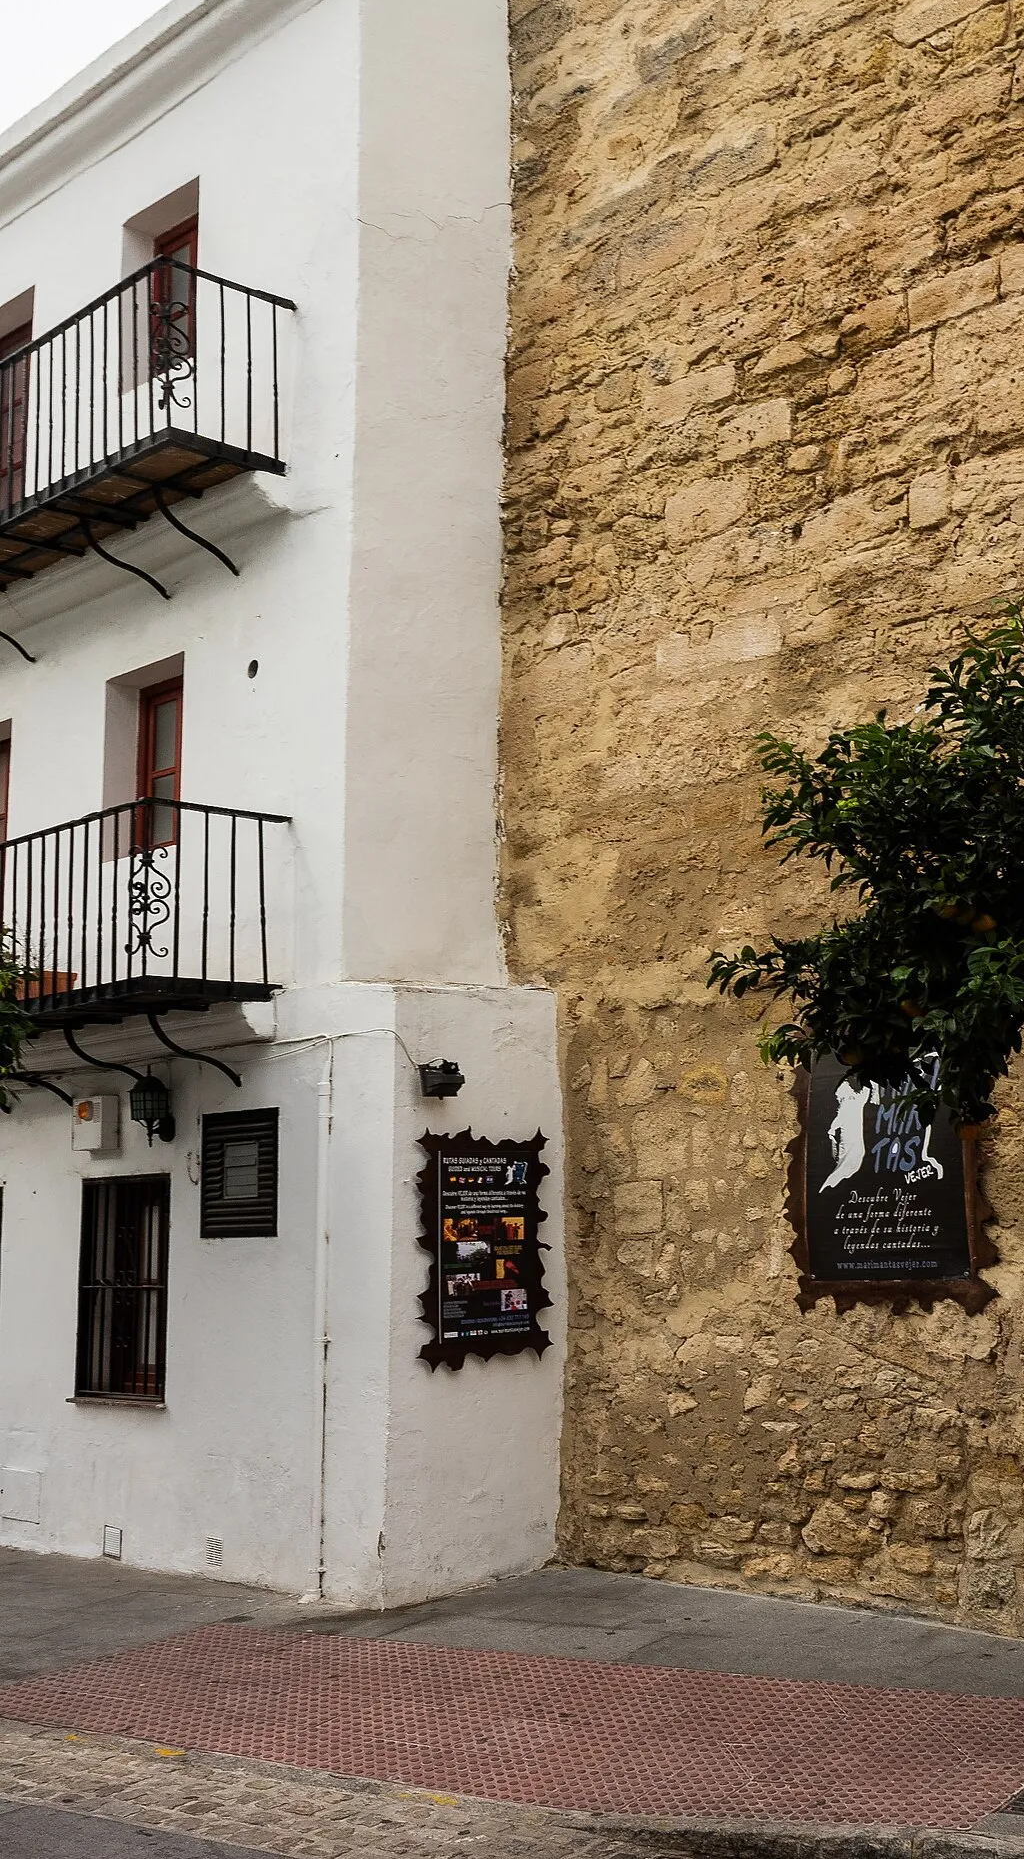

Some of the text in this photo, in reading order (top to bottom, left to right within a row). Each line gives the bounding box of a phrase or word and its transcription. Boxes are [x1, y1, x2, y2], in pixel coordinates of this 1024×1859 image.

[871, 1135, 921, 1173] TAS
[904, 1165, 934, 1184] VEJER
[848, 1187, 917, 1204] Descubre Vejer
[835, 1204, 845, 1219] de
[863, 1204, 890, 1222] forma
[893, 1202, 932, 1221] diferente
[870, 1219, 880, 1233] de
[896, 1221, 930, 1233] historia
[931, 1225, 939, 1236] y
[882, 1233, 931, 1249] cantadas...
[836, 1259, 938, 1270] www.marimantasvejer.com
